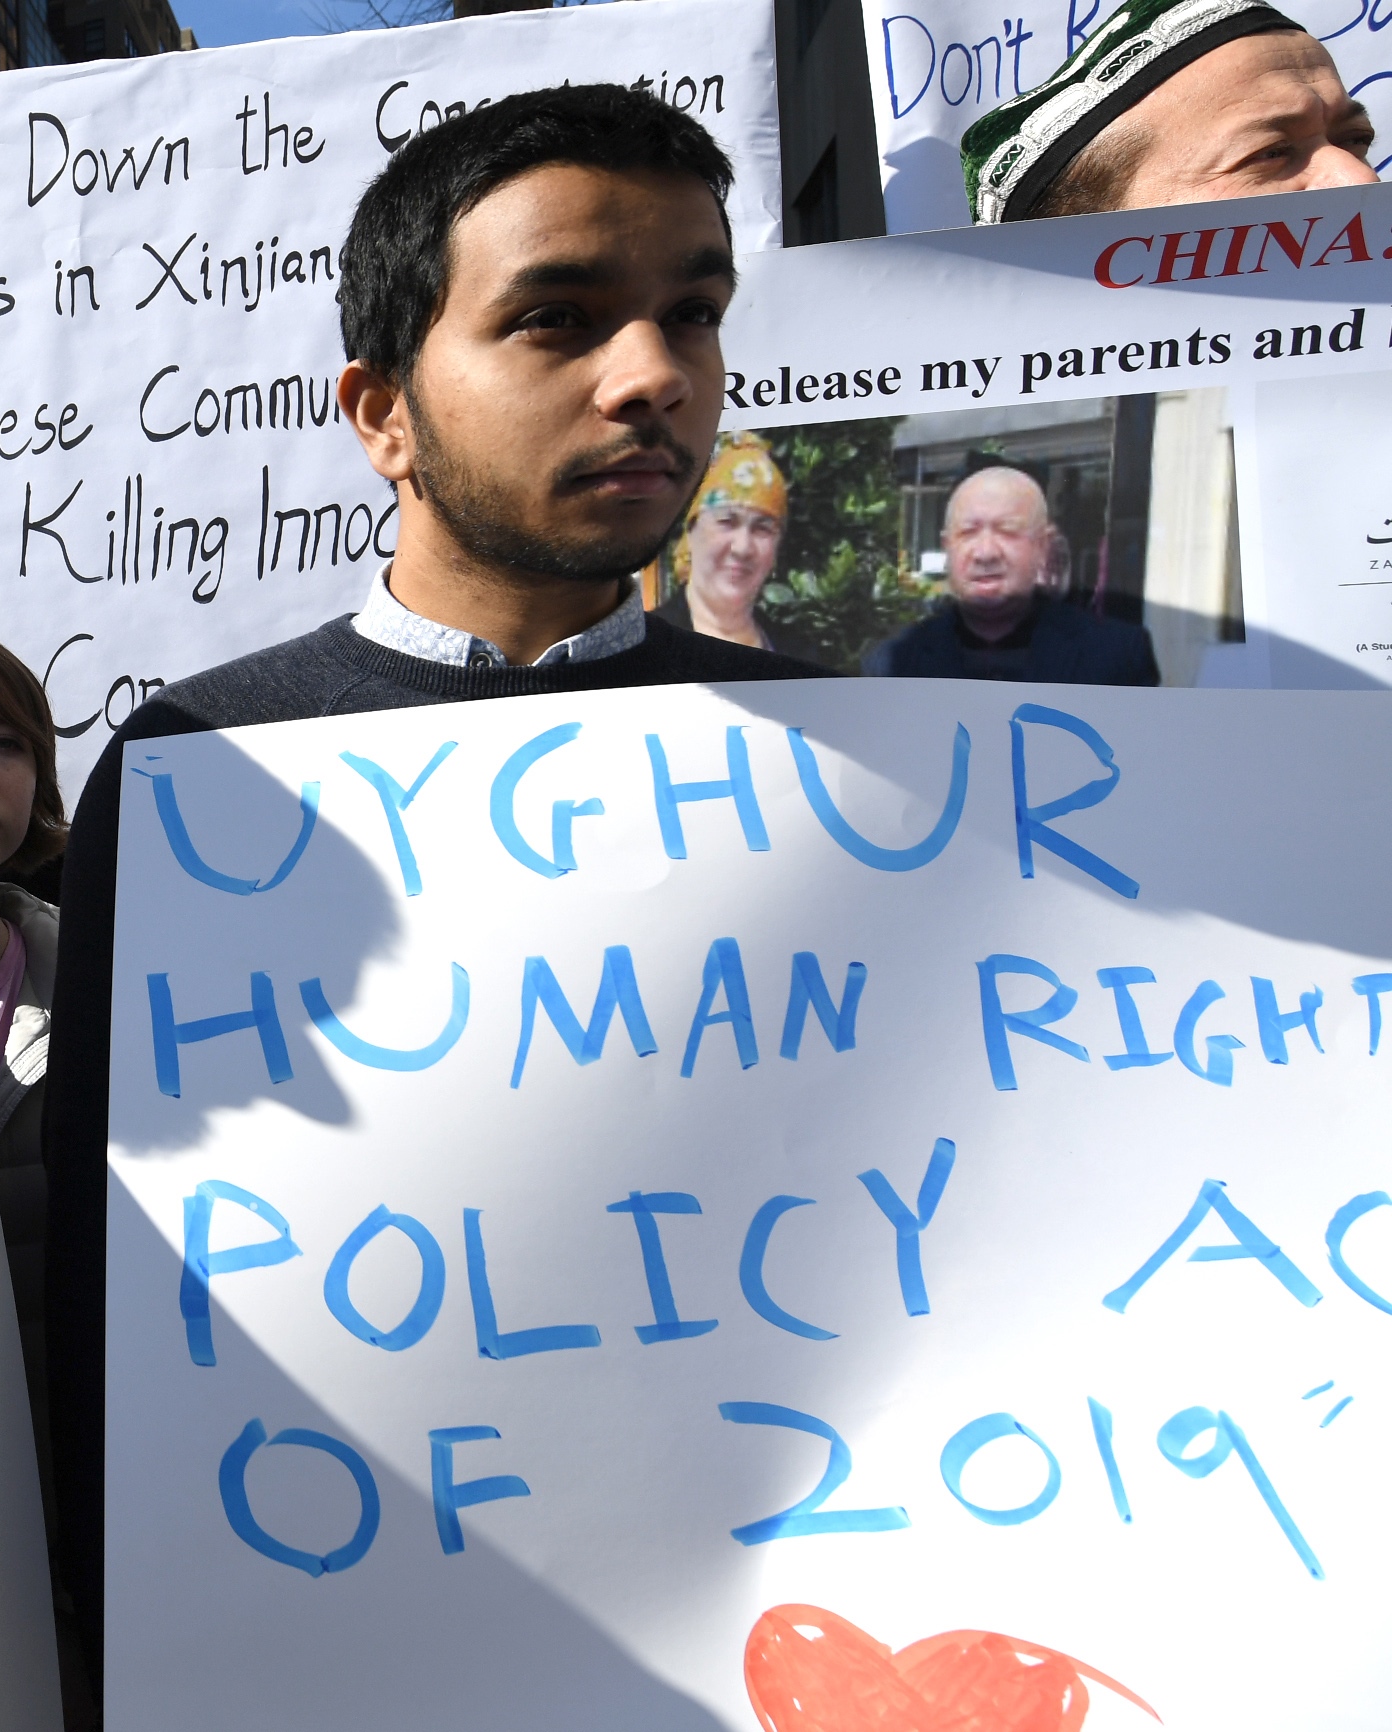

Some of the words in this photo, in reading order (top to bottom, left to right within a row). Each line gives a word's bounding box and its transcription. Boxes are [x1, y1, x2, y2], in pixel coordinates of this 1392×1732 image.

[882, 15, 1033, 119] Don't
[27, 112, 190, 208] Down
[235, 91, 326, 176] the
[54, 259, 101, 318] in
[135, 232, 344, 313] Xinjian
[139, 364, 340, 443] Commu
[722, 366, 902, 410] Release
[920, 354, 1005, 398] my
[1019, 327, 1232, 395] parents
[1253, 307, 1366, 360] and
[18, 472, 229, 606] Killing
[145, 936, 869, 1100] HUMAN
[178, 1136, 958, 1369] POLICY
[217, 1416, 532, 1580] OF
